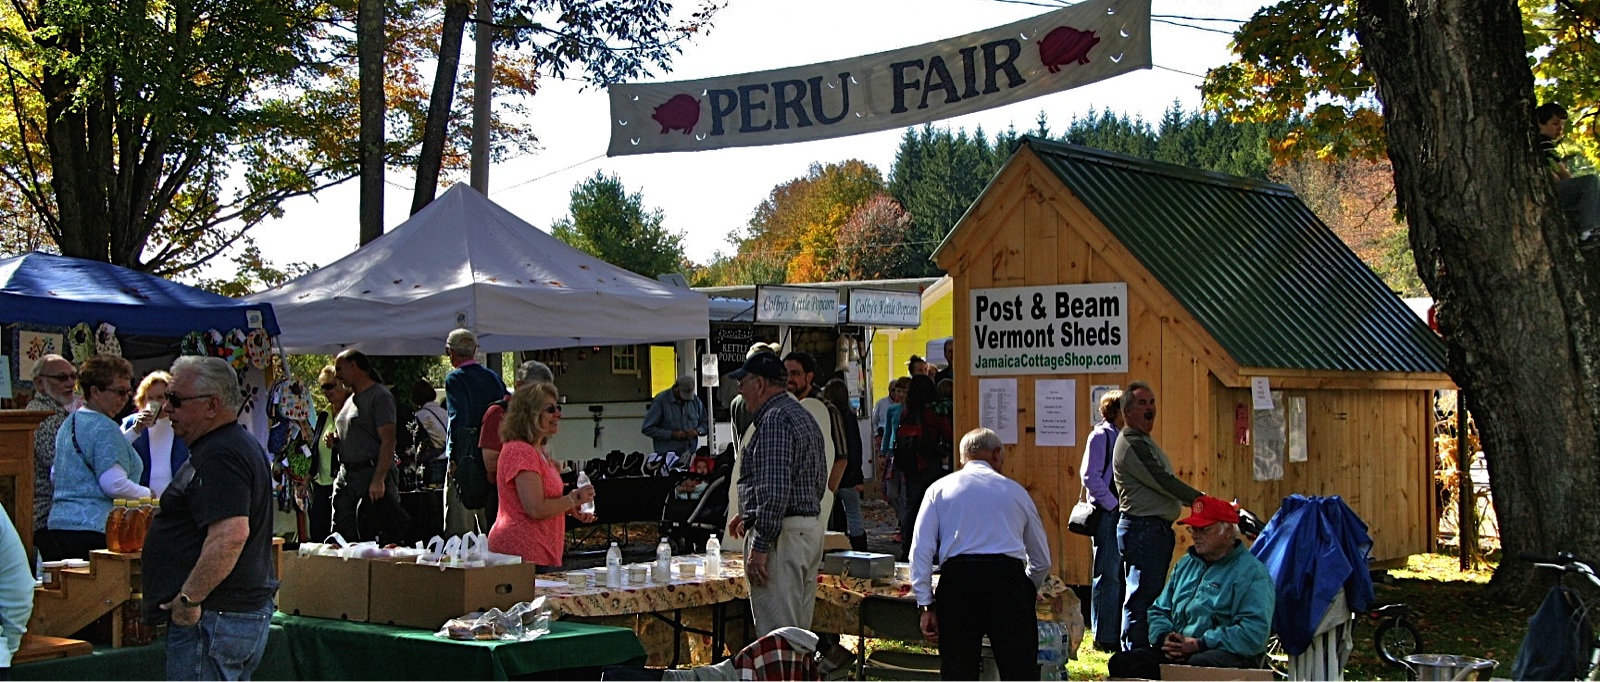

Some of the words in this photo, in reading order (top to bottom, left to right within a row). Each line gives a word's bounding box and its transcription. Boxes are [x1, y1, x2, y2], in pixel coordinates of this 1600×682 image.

[706, 71, 854, 137] PERU
[889, 37, 1027, 114] FAIR
[763, 294, 789, 317] Colby's
[791, 293, 811, 315] Kettle
[811, 295, 835, 316] Popcorn
[855, 297, 878, 319] Colby's
[879, 299, 896, 318] Kettle
[896, 300, 918, 321] Popcorn
[976, 294, 1023, 322] Post
[1030, 292, 1047, 320] &
[1055, 291, 1120, 319] Beam
[974, 322, 1055, 350] Vermont
[1060, 320, 1122, 348] Sheds
[718, 351, 747, 363] POPCOR
[722, 343, 749, 354] KETTLE
[975, 351, 1122, 371] JamaicaCottageShop.com
